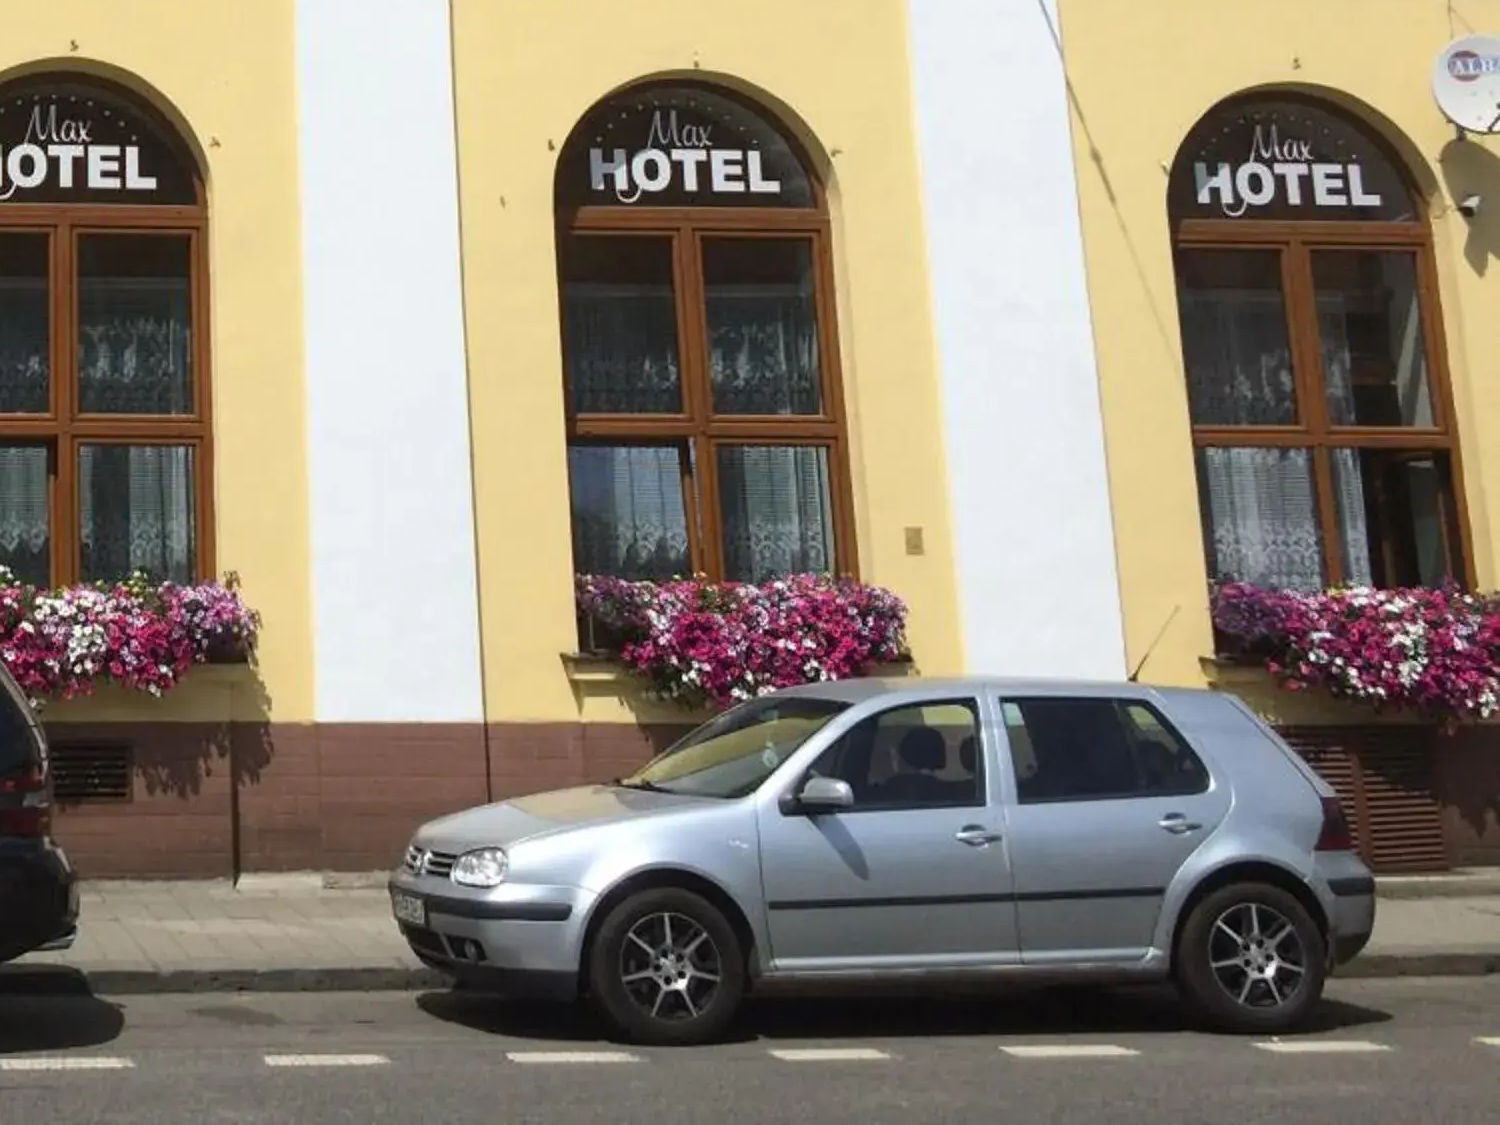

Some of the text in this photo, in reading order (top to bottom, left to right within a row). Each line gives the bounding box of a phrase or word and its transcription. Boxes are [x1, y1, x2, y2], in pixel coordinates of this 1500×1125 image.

[25, 104, 93, 143] Max
[648, 110, 713, 147] Max
[1251, 123, 1315, 161] Max
[589, 148, 781, 193] HOTEL
[1194, 162, 1381, 207] HOTEL
